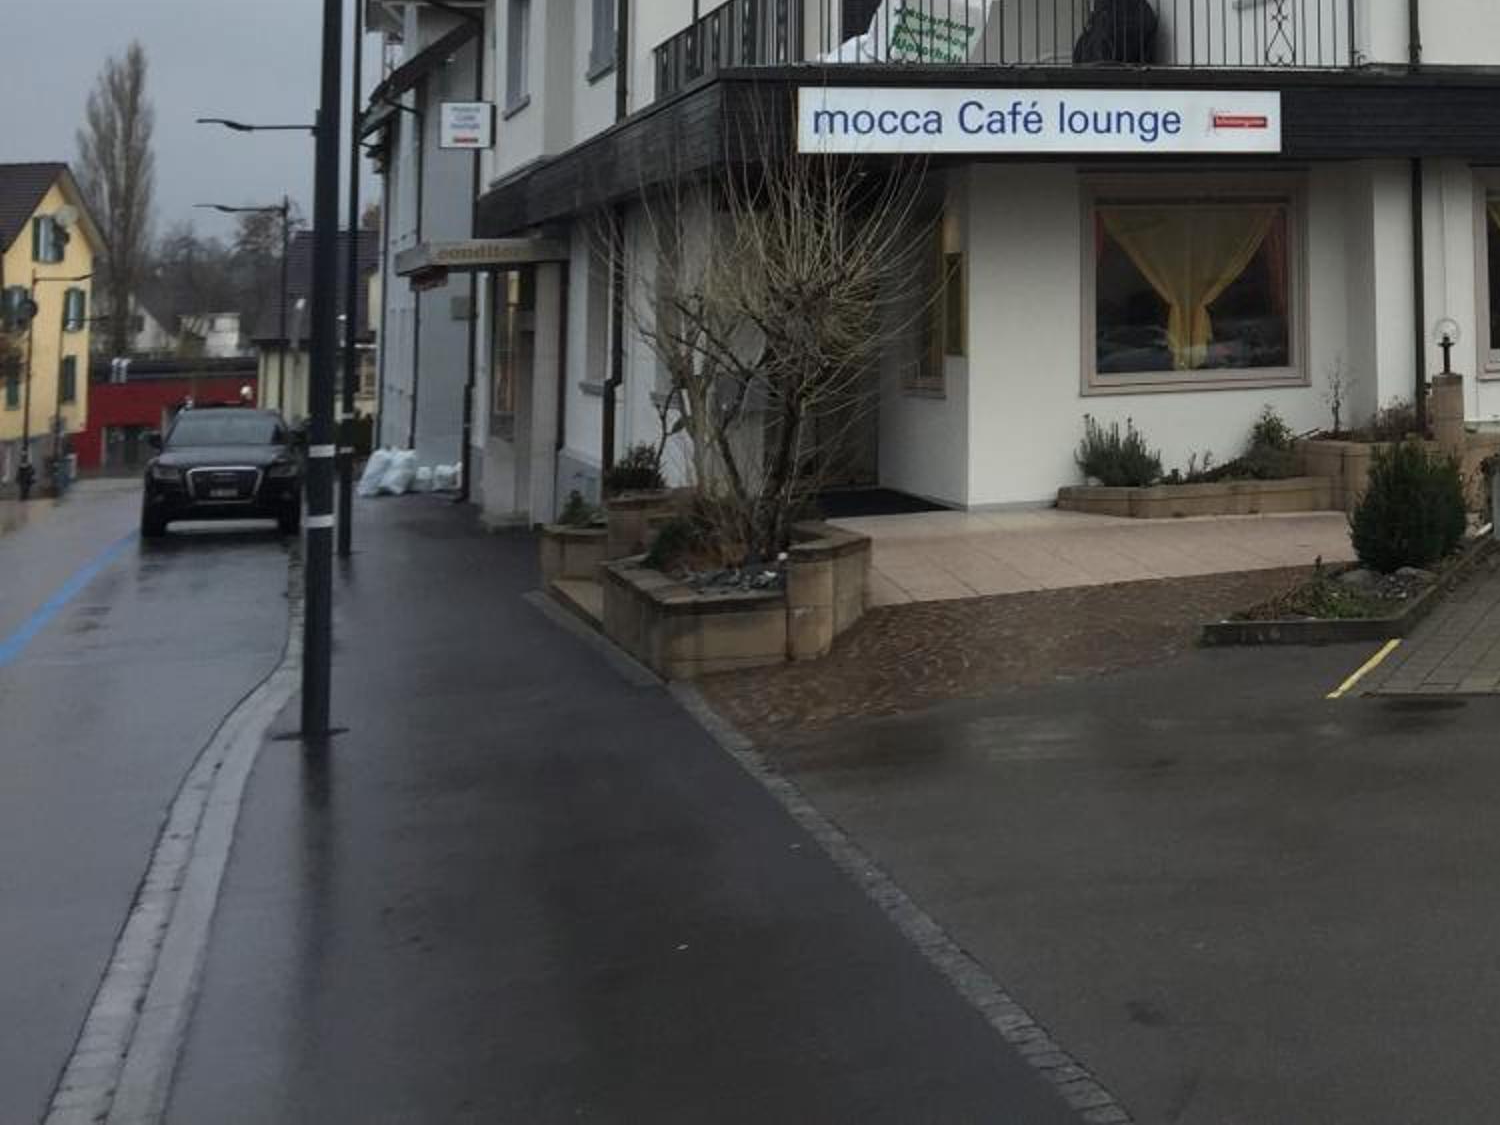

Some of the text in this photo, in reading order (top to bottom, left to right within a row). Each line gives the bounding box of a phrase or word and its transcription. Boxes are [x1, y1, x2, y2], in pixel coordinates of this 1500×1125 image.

[812, 100, 1182, 142] mocca Café lounge
